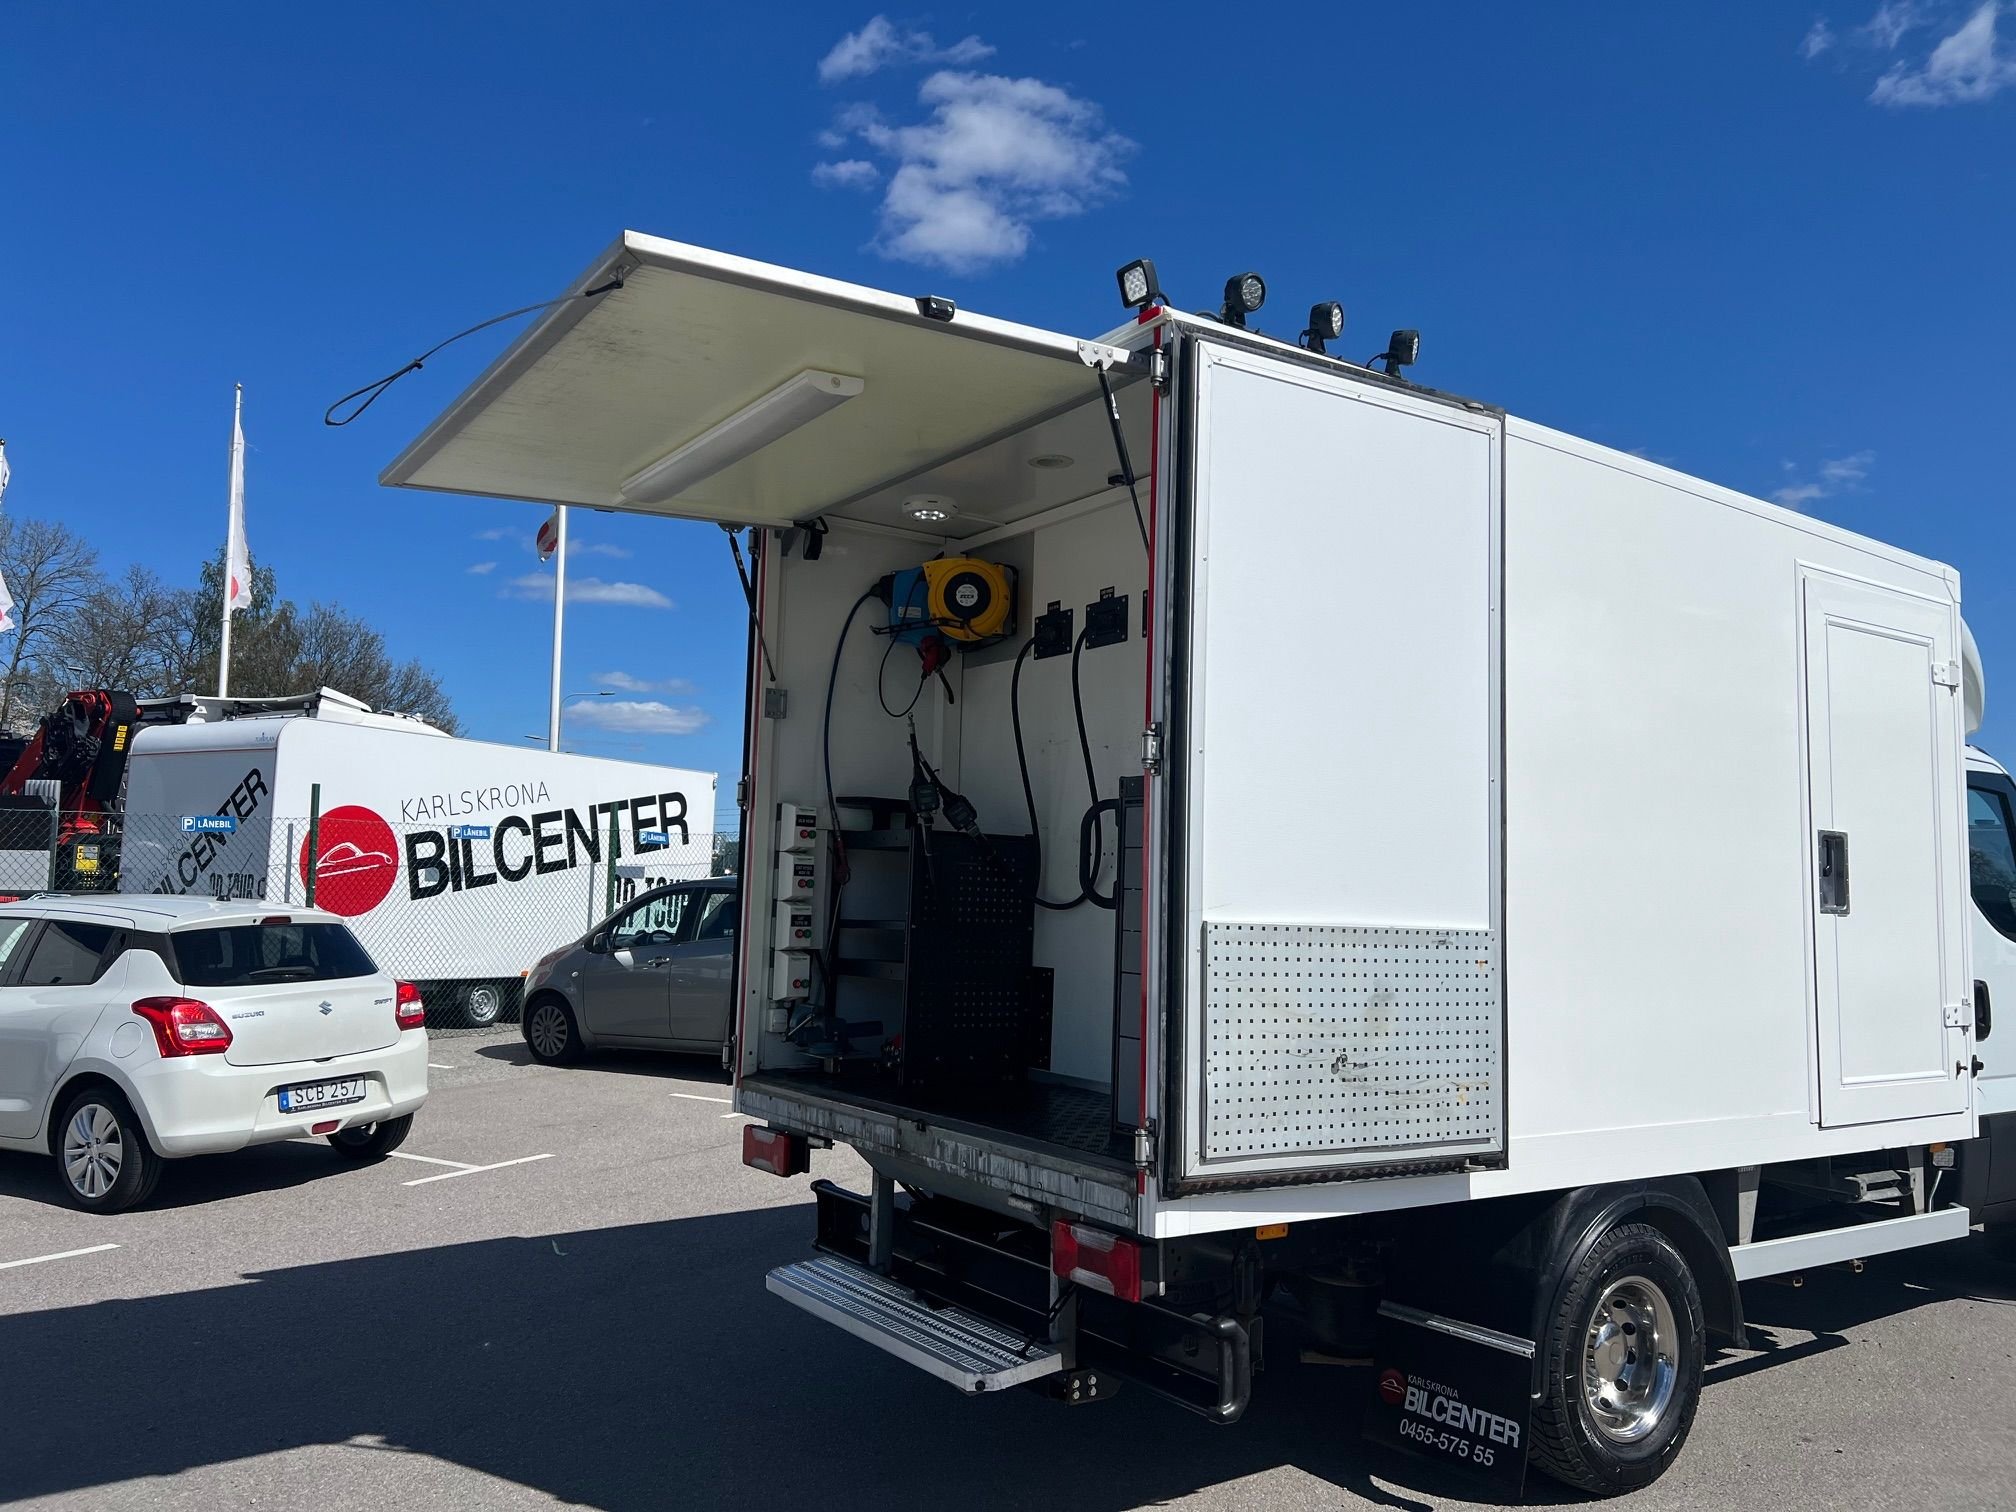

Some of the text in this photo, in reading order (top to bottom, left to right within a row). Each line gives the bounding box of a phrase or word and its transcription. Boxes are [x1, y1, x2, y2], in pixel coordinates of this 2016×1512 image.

[401, 781, 551, 822] KARLSKRONA
[183, 818, 232, 830] P LÅNEBIL
[463, 828, 488, 838] LÅNEBIL
[404, 791, 690, 901] BILCENTER
[374, 997, 393, 1006] SWIFT
[231, 1010, 265, 1020] SUZUKI
[295, 1079, 358, 1104] SCB 257
[1407, 1374, 1459, 1400] KARLSKRONA
[1404, 1385, 1521, 1449] BILCENTER
[1400, 1418, 1495, 1467] 0455-575 55
